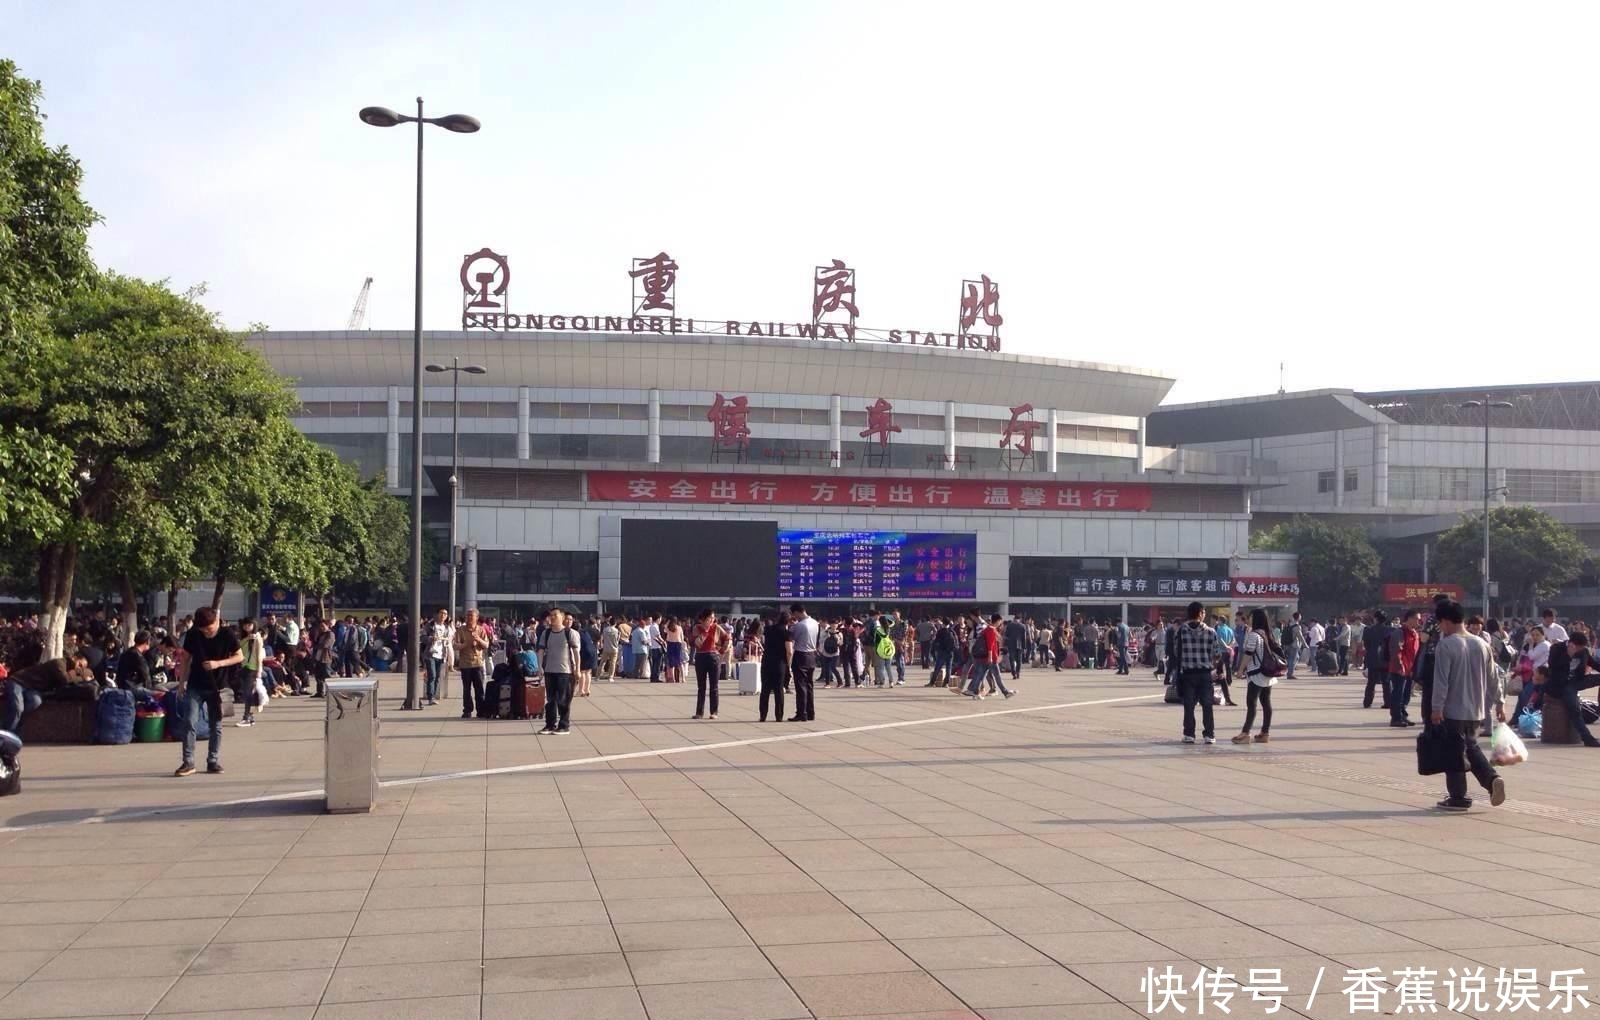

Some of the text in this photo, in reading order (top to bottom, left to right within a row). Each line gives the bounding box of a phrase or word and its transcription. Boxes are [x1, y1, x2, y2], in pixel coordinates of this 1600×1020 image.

[628, 252, 1003, 327] 重庆北
[462, 313, 1001, 352] CHONGQINGBEI RAILWAY STATION
[627, 478, 1120, 507] 安全出行 方便出行 温馨出行
[1091, 578, 1148, 592] 行李寄存
[1175, 578, 1232, 593] 旅客超市
